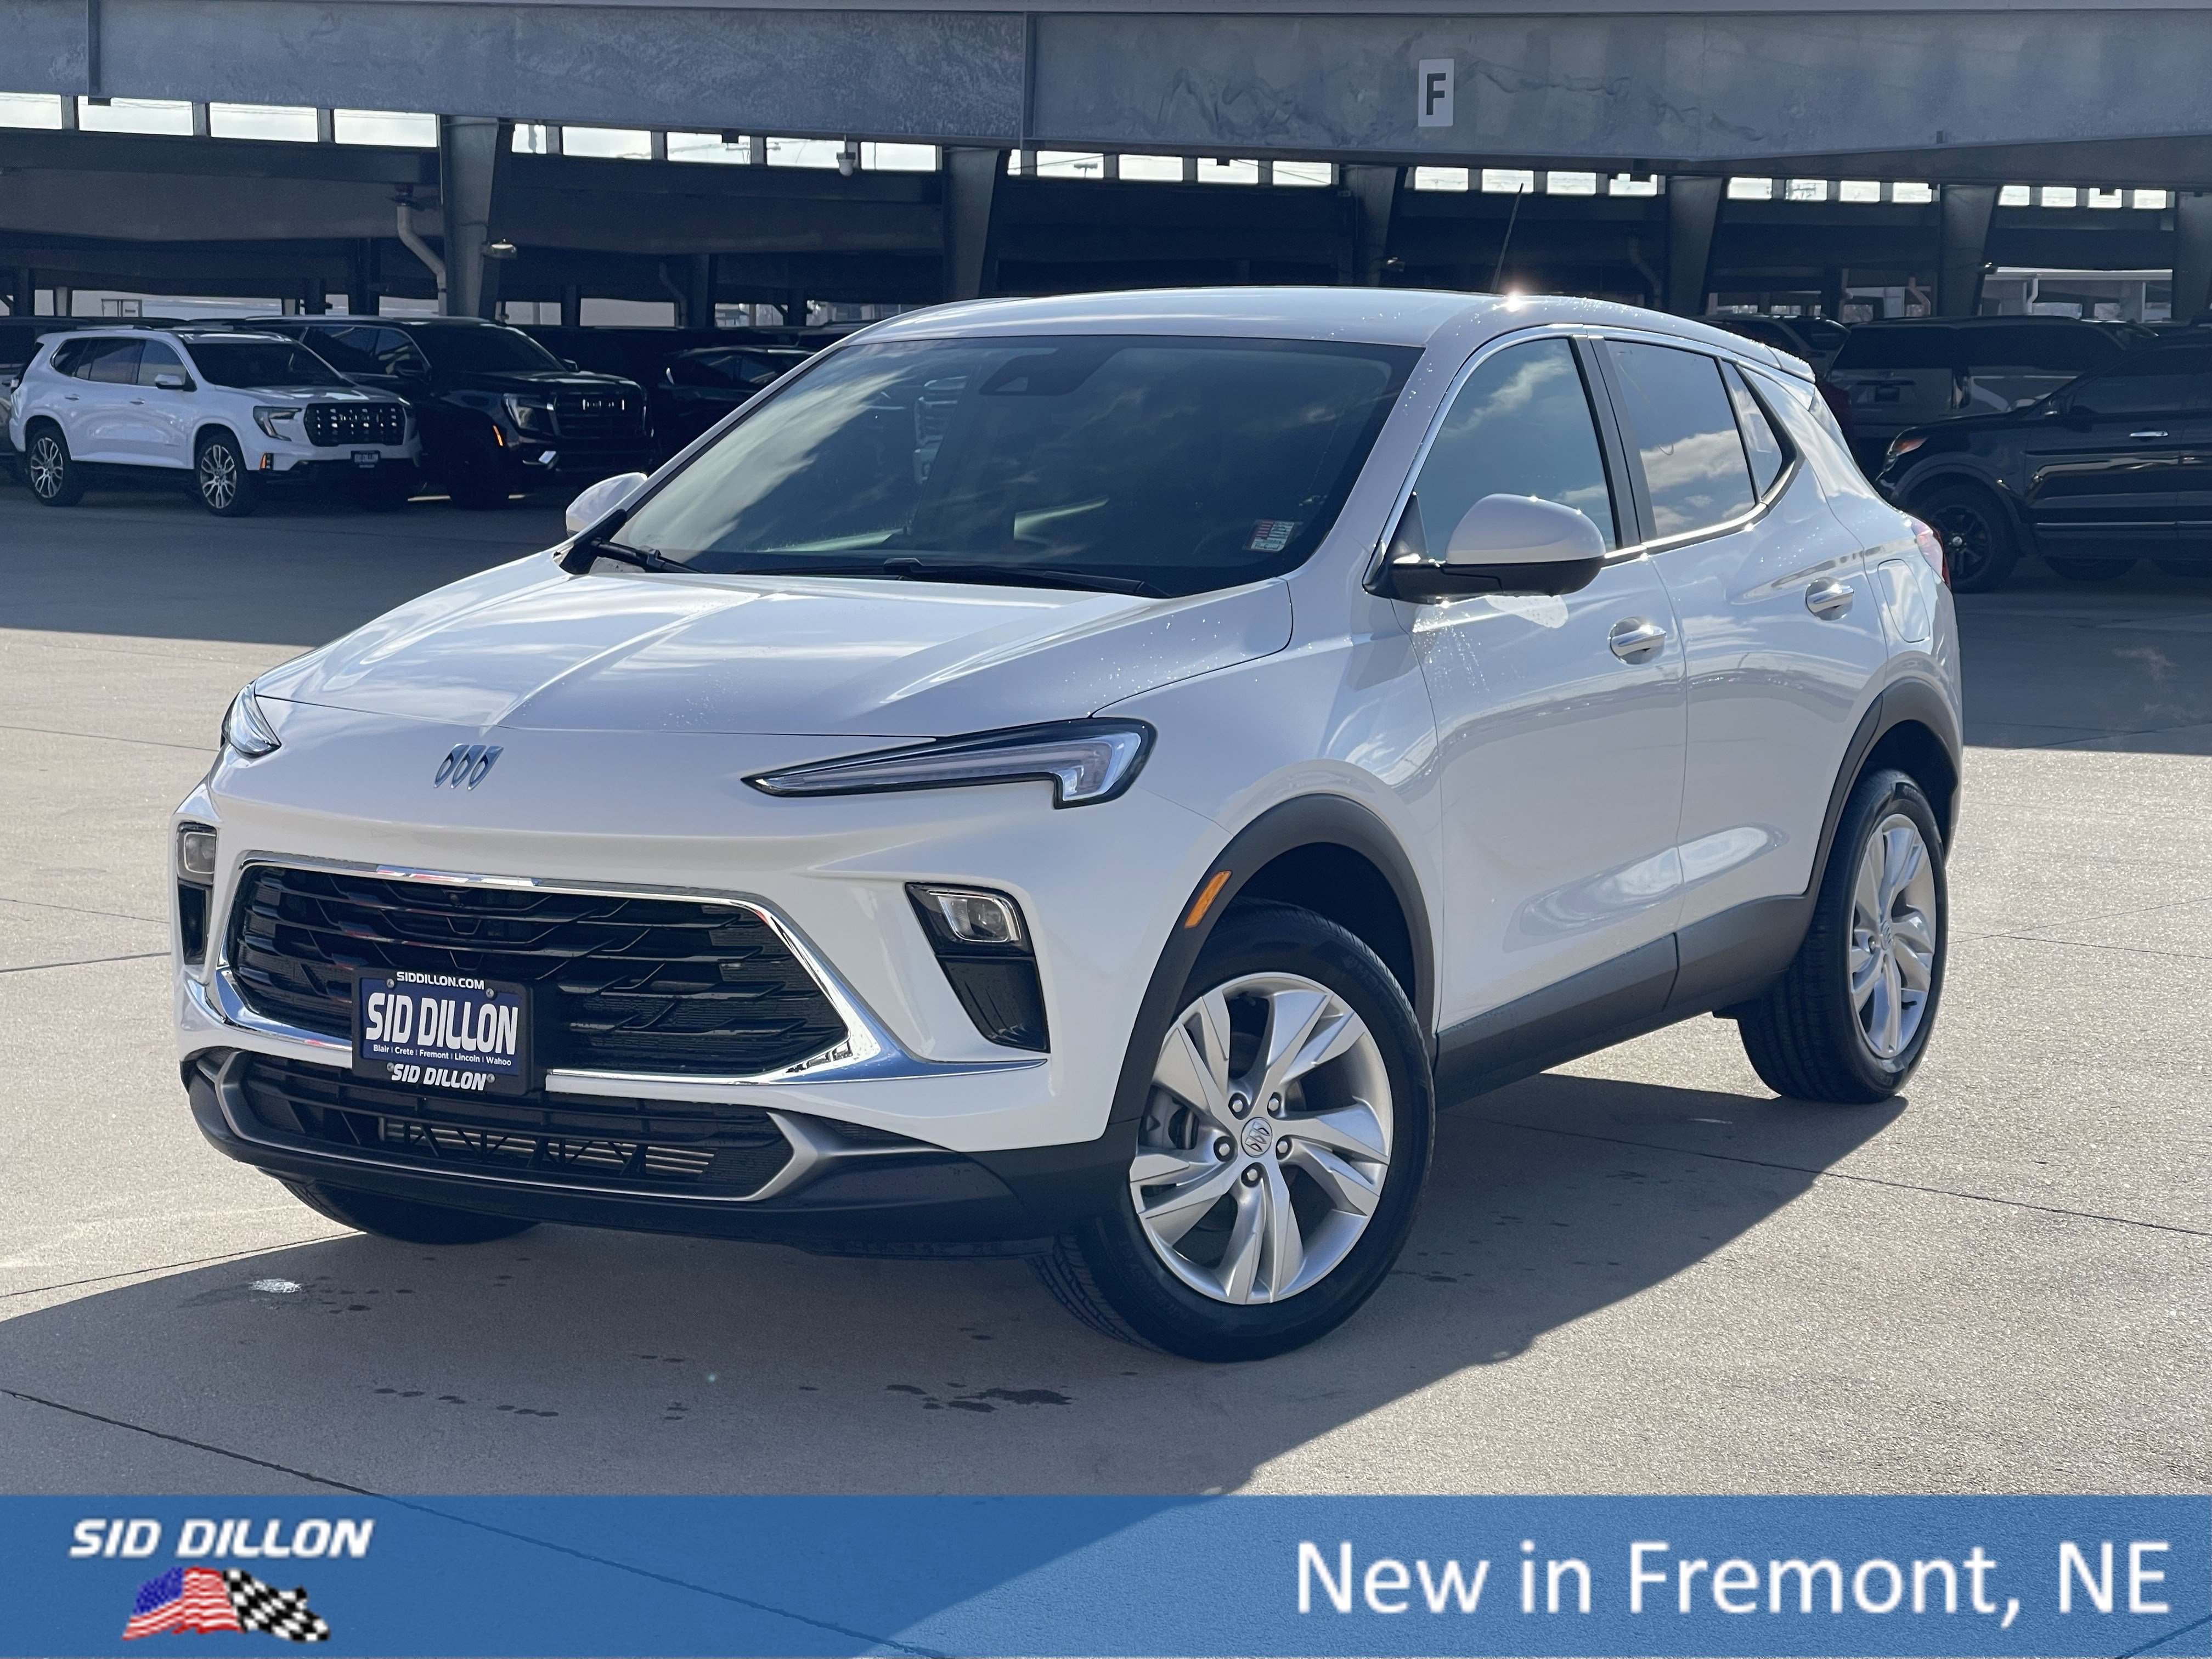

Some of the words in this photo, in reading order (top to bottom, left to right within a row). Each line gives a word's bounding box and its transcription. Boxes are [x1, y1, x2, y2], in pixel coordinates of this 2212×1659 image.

[1426, 72, 1446, 115] F
[397, 971, 484, 990] SIDDILLON.COM
[366, 992, 413, 1043] SID
[417, 997, 518, 1055] DILLON
[373, 1043, 390, 1053] Blair
[394, 1046, 414, 1056] Crete
[419, 1049, 449, 1060] Fremont
[454, 1053, 480, 1063] Lincoln
[486, 1056, 512, 1066] Wahoo
[391, 1063, 421, 1084] SID
[423, 1068, 487, 1091] DILLON
